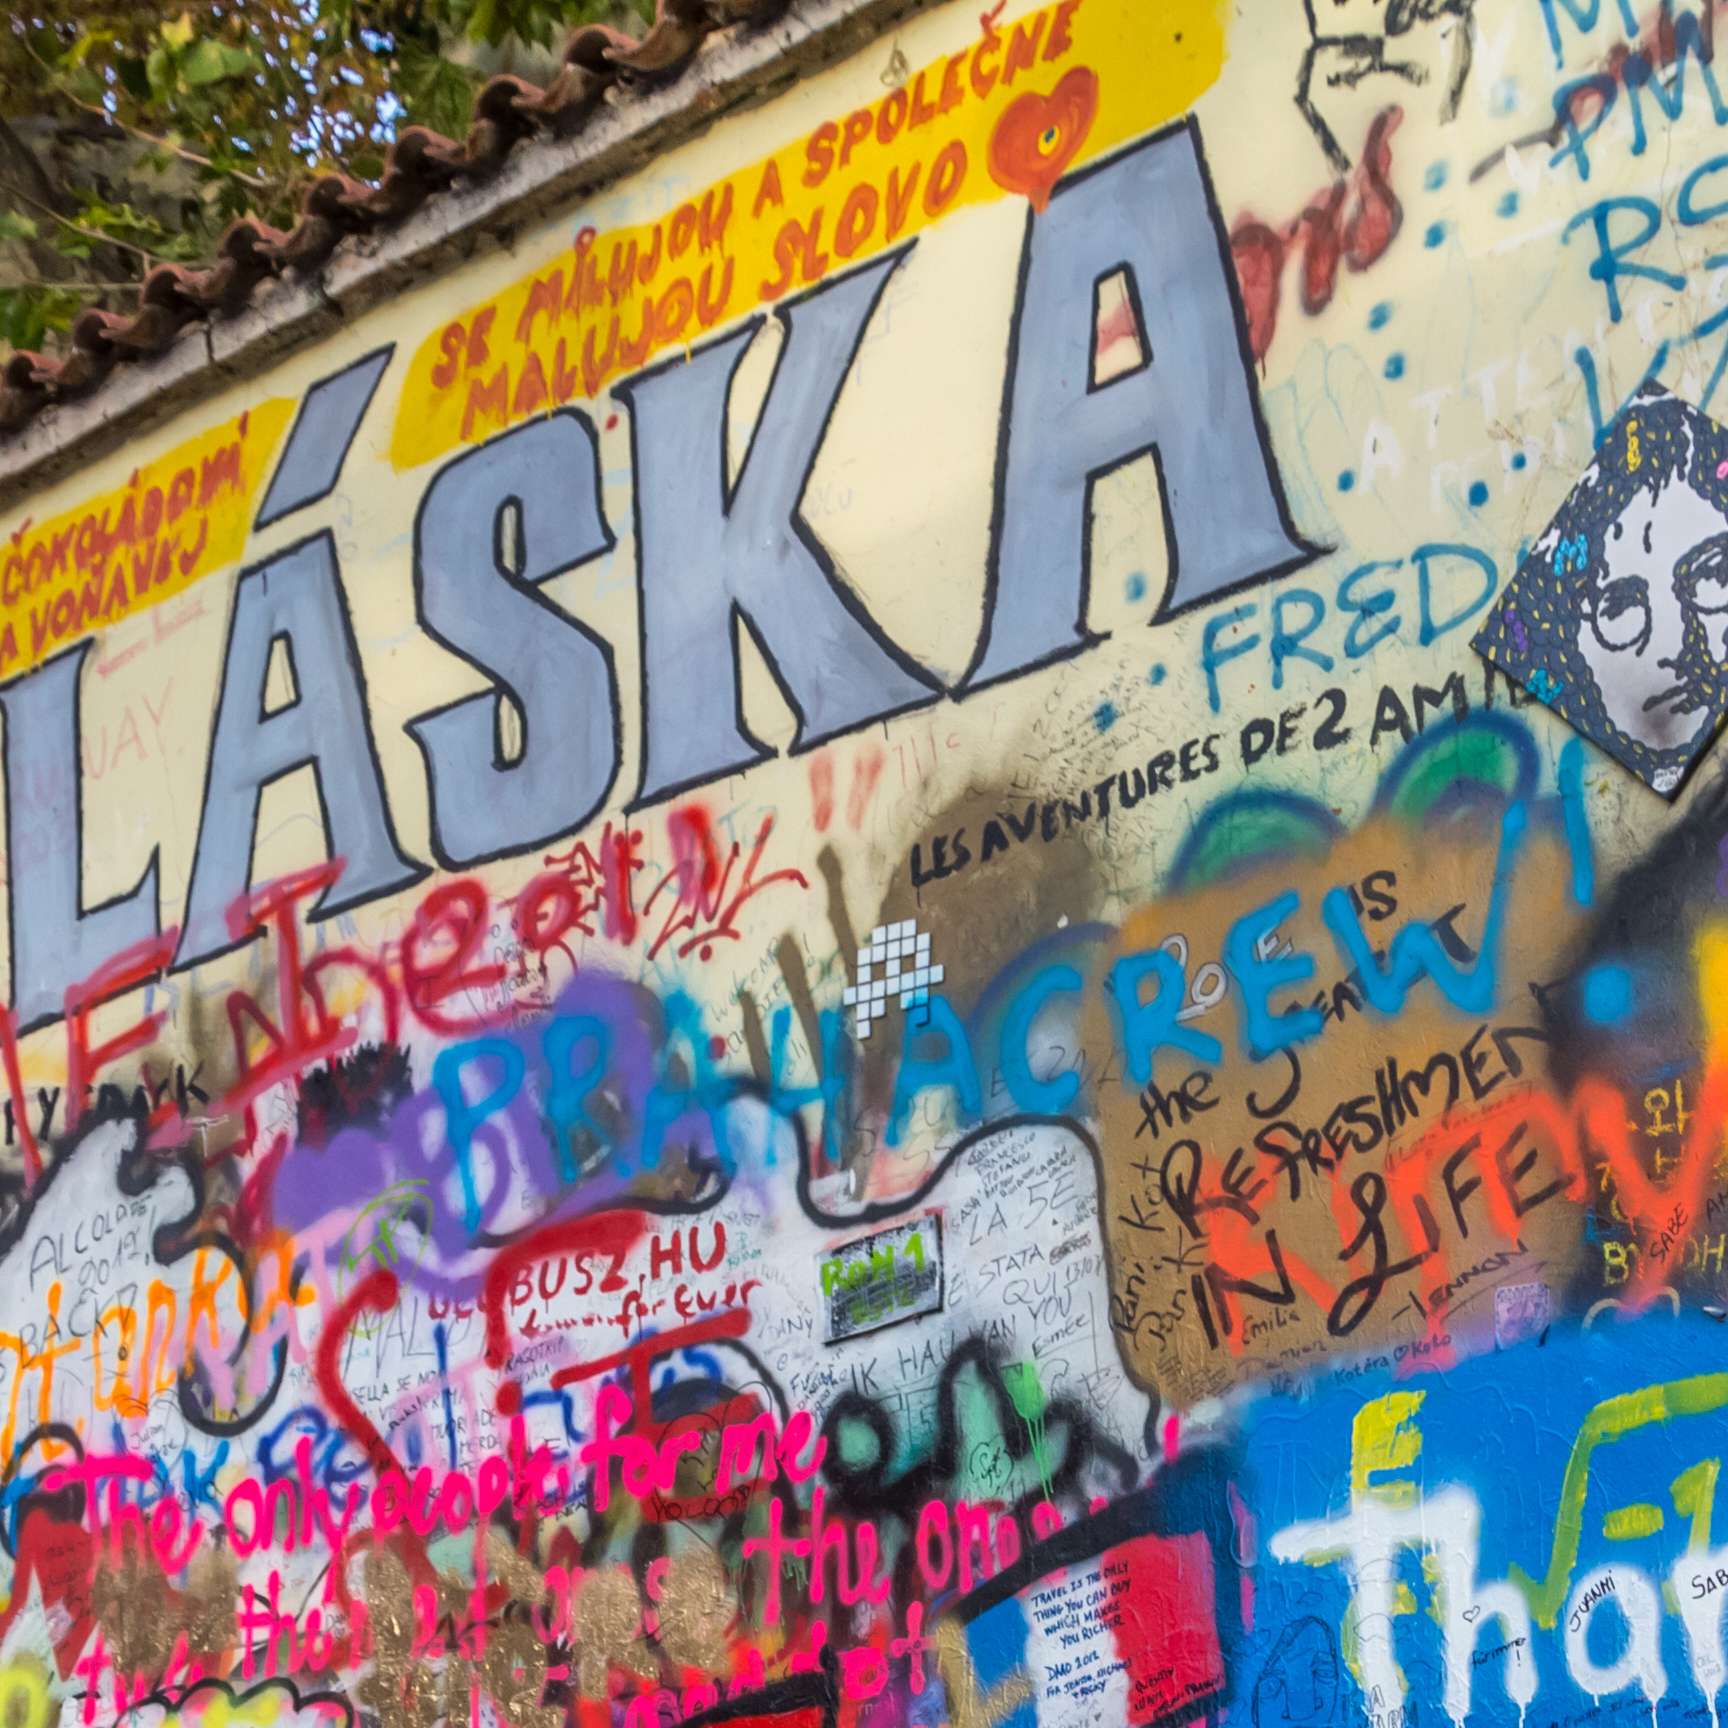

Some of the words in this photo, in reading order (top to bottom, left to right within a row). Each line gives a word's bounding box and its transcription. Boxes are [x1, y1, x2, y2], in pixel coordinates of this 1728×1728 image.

[1202, 543, 1499, 715] FRED
[909, 835, 971, 908] LES
[981, 728, 1222, 866] AVENTURES
[1239, 702, 1308, 771] DE
[1313, 687, 1354, 751] 2
[1031, 1586, 1068, 1608] TRAVEL
[1033, 1606, 1063, 1623] THING
[1065, 1599, 1084, 1613] YOU
[1086, 1587, 1108, 1607] CAN
[1110, 1580, 1131, 1595] BUY
[1044, 1615, 1080, 1637] WHICH
[1059, 1633, 1080, 1650] YOU
